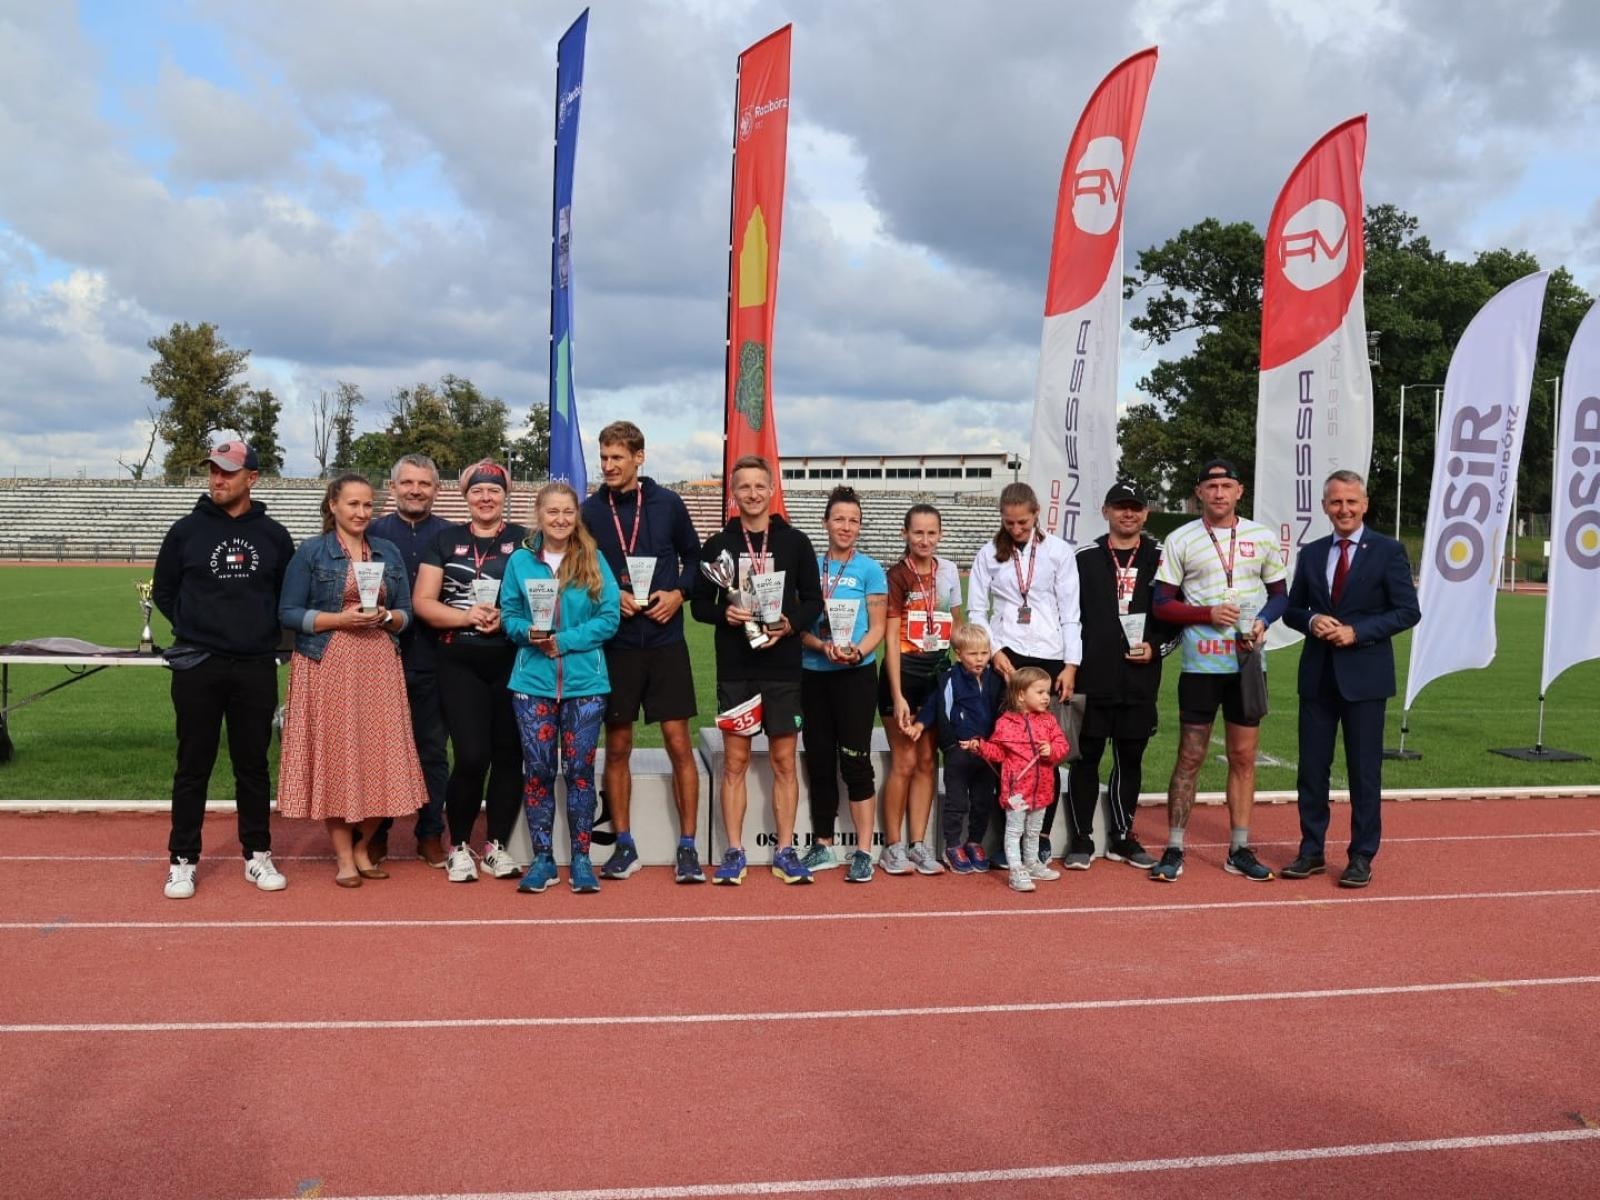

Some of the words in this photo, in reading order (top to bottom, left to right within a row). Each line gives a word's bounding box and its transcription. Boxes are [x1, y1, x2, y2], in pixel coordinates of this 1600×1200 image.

[1062, 319, 1092, 545] ANESSA
[1296, 370, 1314, 546] NESSA
[1496, 404, 1520, 514] RACIBÓRZ
[1436, 404, 1501, 582] OSiR
[210, 540, 228, 574] TOMMY
[233, 538, 260, 572] HILFIGER
[1197, 639, 1233, 656] ULT
[732, 711, 755, 731] 35
[756, 832, 799, 847] OSR
